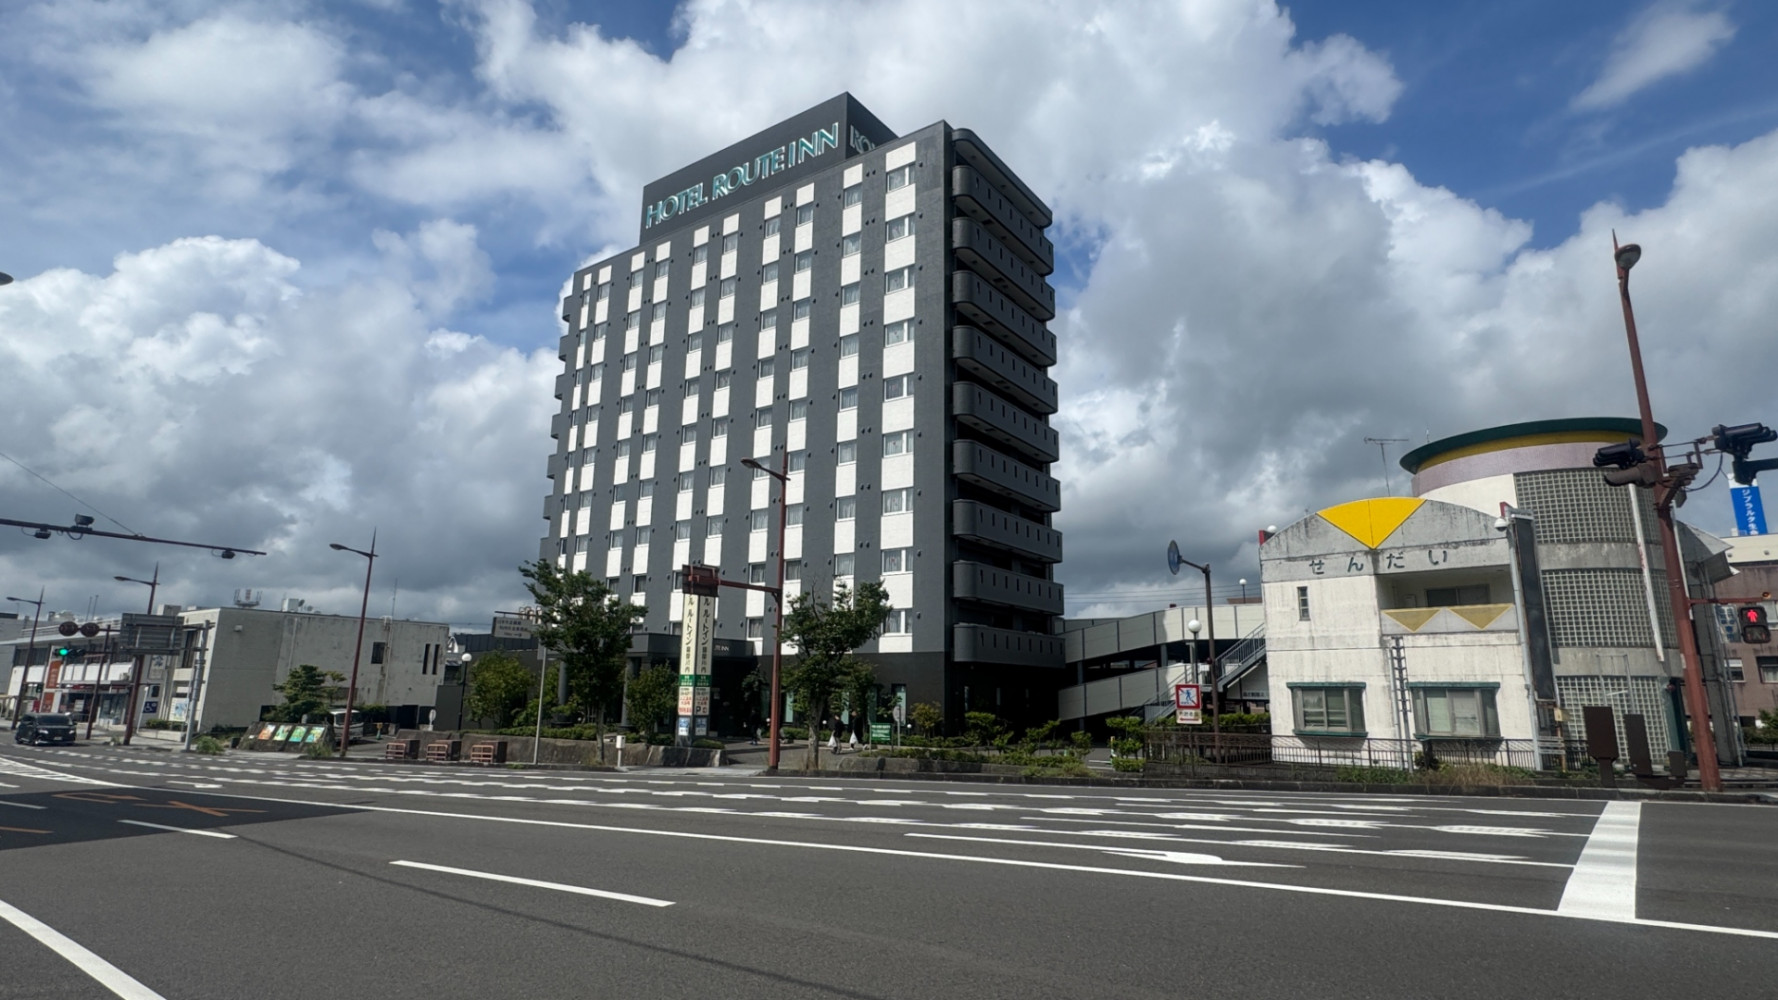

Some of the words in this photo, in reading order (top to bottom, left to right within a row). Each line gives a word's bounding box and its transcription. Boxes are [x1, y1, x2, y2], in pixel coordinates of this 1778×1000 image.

[849, 124, 876, 154] RO
[645, 182, 708, 229] HOTEL
[712, 146, 785, 200] ROUTE
[788, 122, 839, 169] INN
[1309, 549, 1448, 575] せんだい
